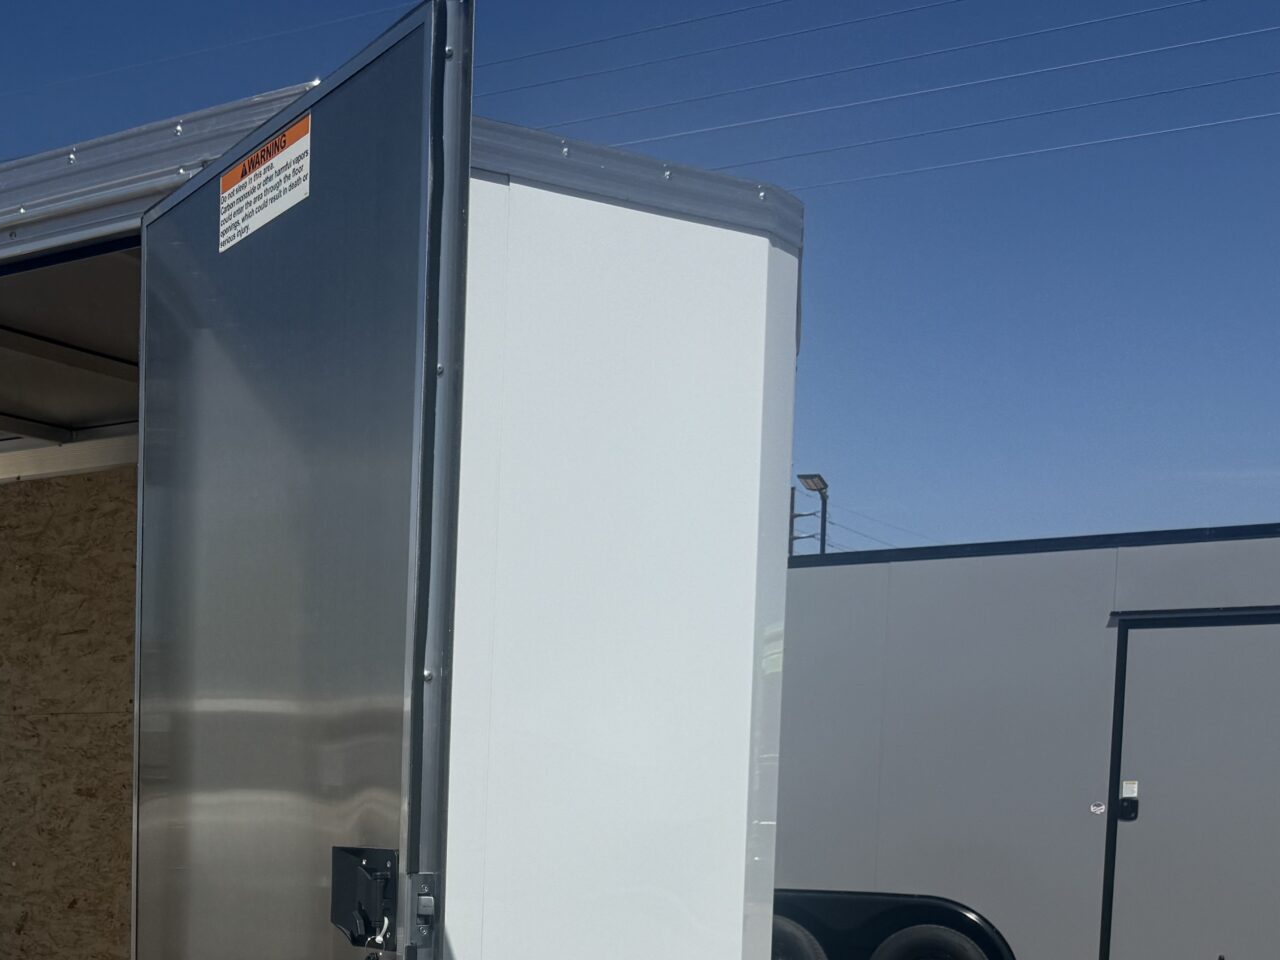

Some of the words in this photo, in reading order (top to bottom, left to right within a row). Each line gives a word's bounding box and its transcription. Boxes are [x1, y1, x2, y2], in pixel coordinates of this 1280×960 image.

[247, 133, 287, 173] WARNING
[220, 211, 233, 227] could
[233, 204, 245, 218] enter
[245, 199, 253, 210] the
[253, 193, 263, 205] area
[264, 178, 282, 197] through
[283, 173, 291, 184] the
[292, 164, 304, 178] floor
[221, 201, 236, 216] Carbon
[236, 185, 256, 206] monoxide
[257, 182, 262, 191] or
[263, 173, 274, 187] other
[275, 158, 292, 179] harmful
[292, 149, 309, 166] vapors
[221, 195, 227, 205] Do
[227, 188, 235, 200] not
[236, 181, 248, 195] sleep
[248, 176, 253, 185] in
[253, 170, 262, 182] this
[241, 208, 255, 223] which
[255, 198, 269, 214] could
[269, 189, 282, 206] result
[282, 186, 287, 196] in
[288, 176, 302, 192] death
[302, 173, 309, 182] or
[220, 233, 236, 249] serious
